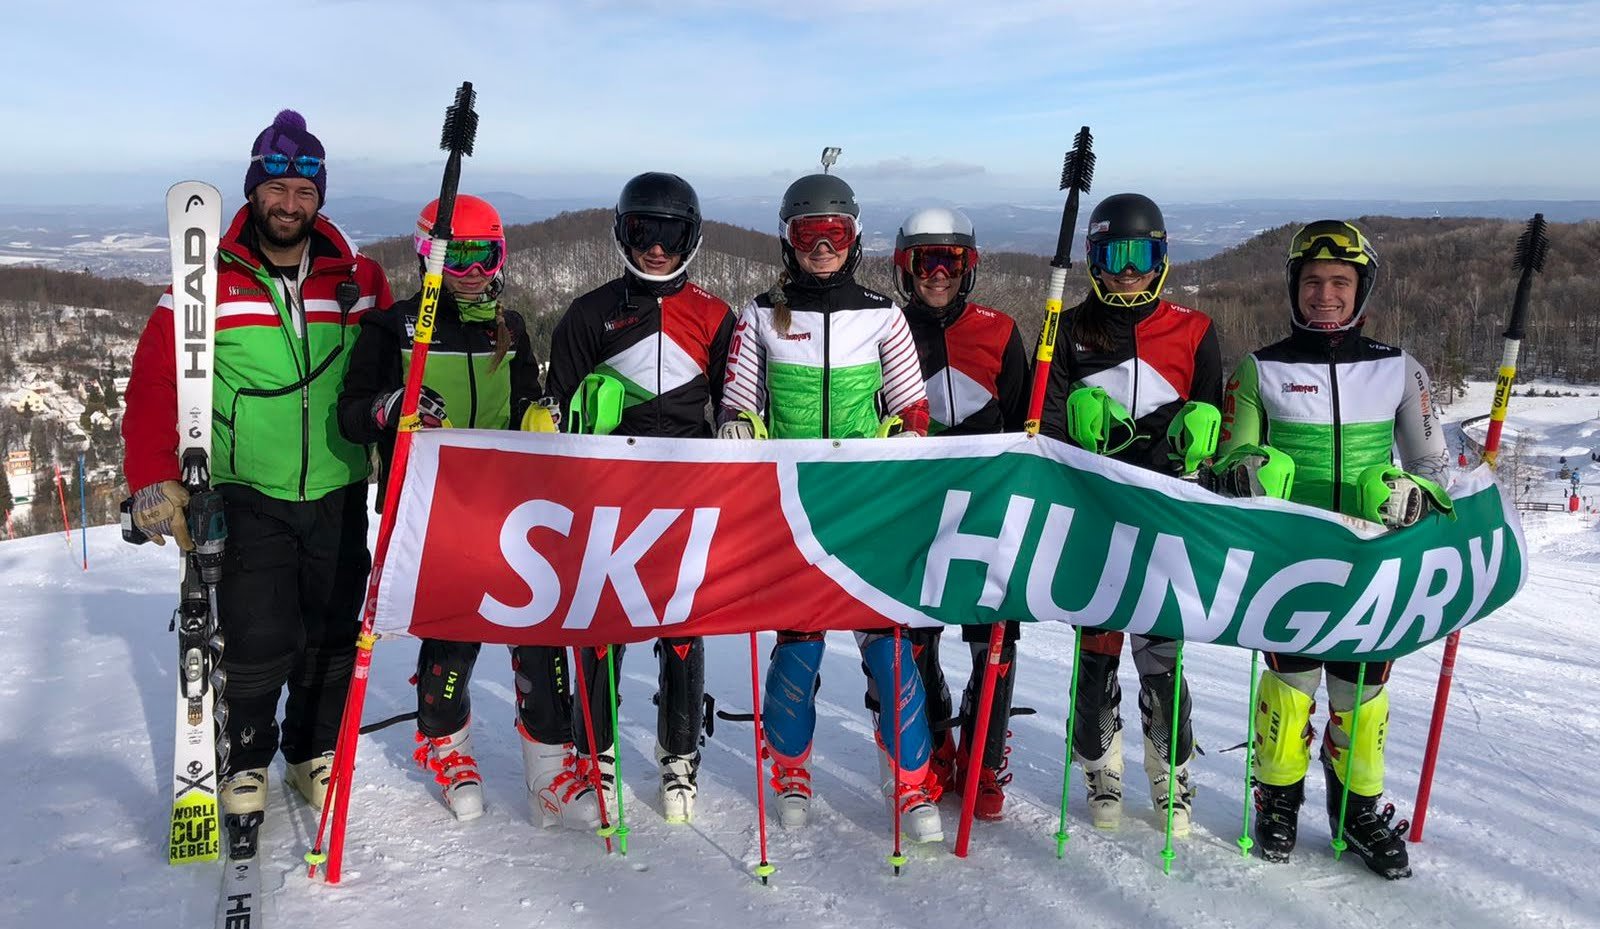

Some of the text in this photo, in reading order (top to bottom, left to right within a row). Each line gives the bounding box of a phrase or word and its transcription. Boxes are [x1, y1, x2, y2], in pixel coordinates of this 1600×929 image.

[184, 227, 206, 379] HEAD
[1414, 371, 1425, 391] Das
[477, 499, 721, 629] SKI
[919, 489, 1503, 655] HUNGARY
[443, 670, 459, 700] LEKI
[554, 656, 562, 694] LEKI
[1269, 711, 1280, 743] LEKI
[1377, 722, 1385, 751] LEKI
[171, 817, 216, 845] CUP
